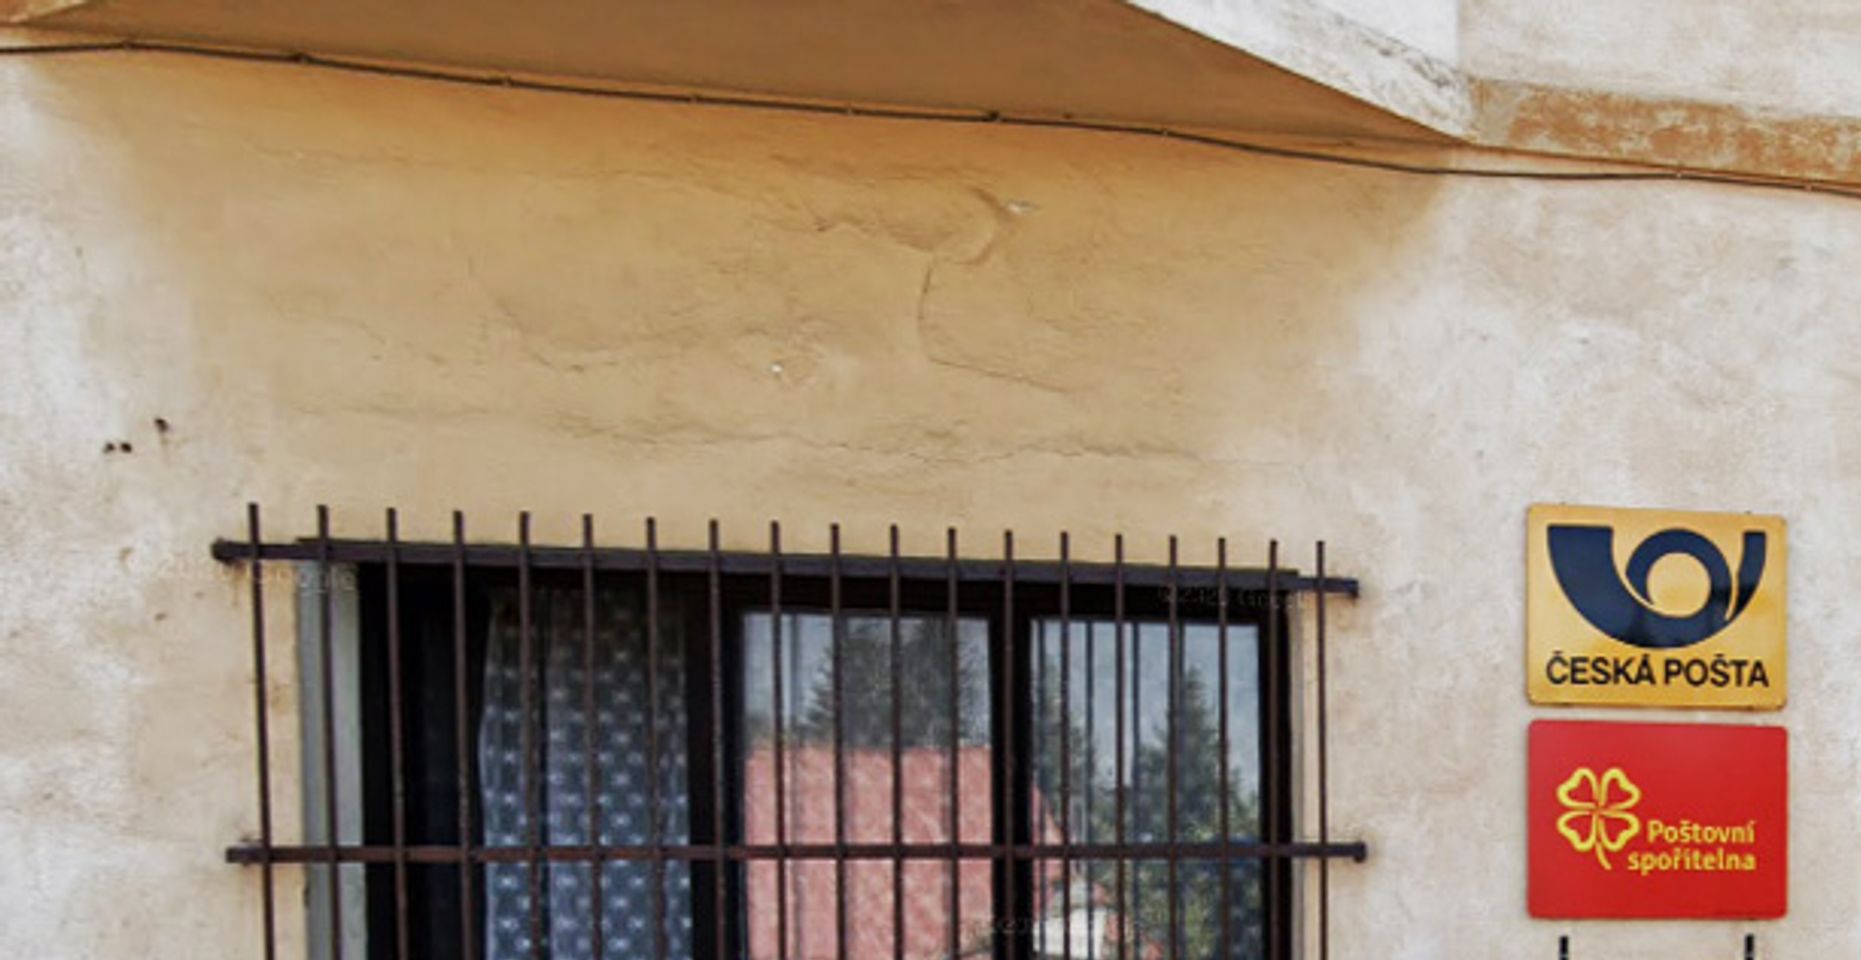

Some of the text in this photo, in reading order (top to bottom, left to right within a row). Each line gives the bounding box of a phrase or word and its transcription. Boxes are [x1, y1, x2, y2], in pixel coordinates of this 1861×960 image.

[1546, 651, 1770, 688] ČESKÁ POŠTA
[1647, 819, 1755, 844] Poštovní
[1627, 847, 1756, 875] spořitelna
